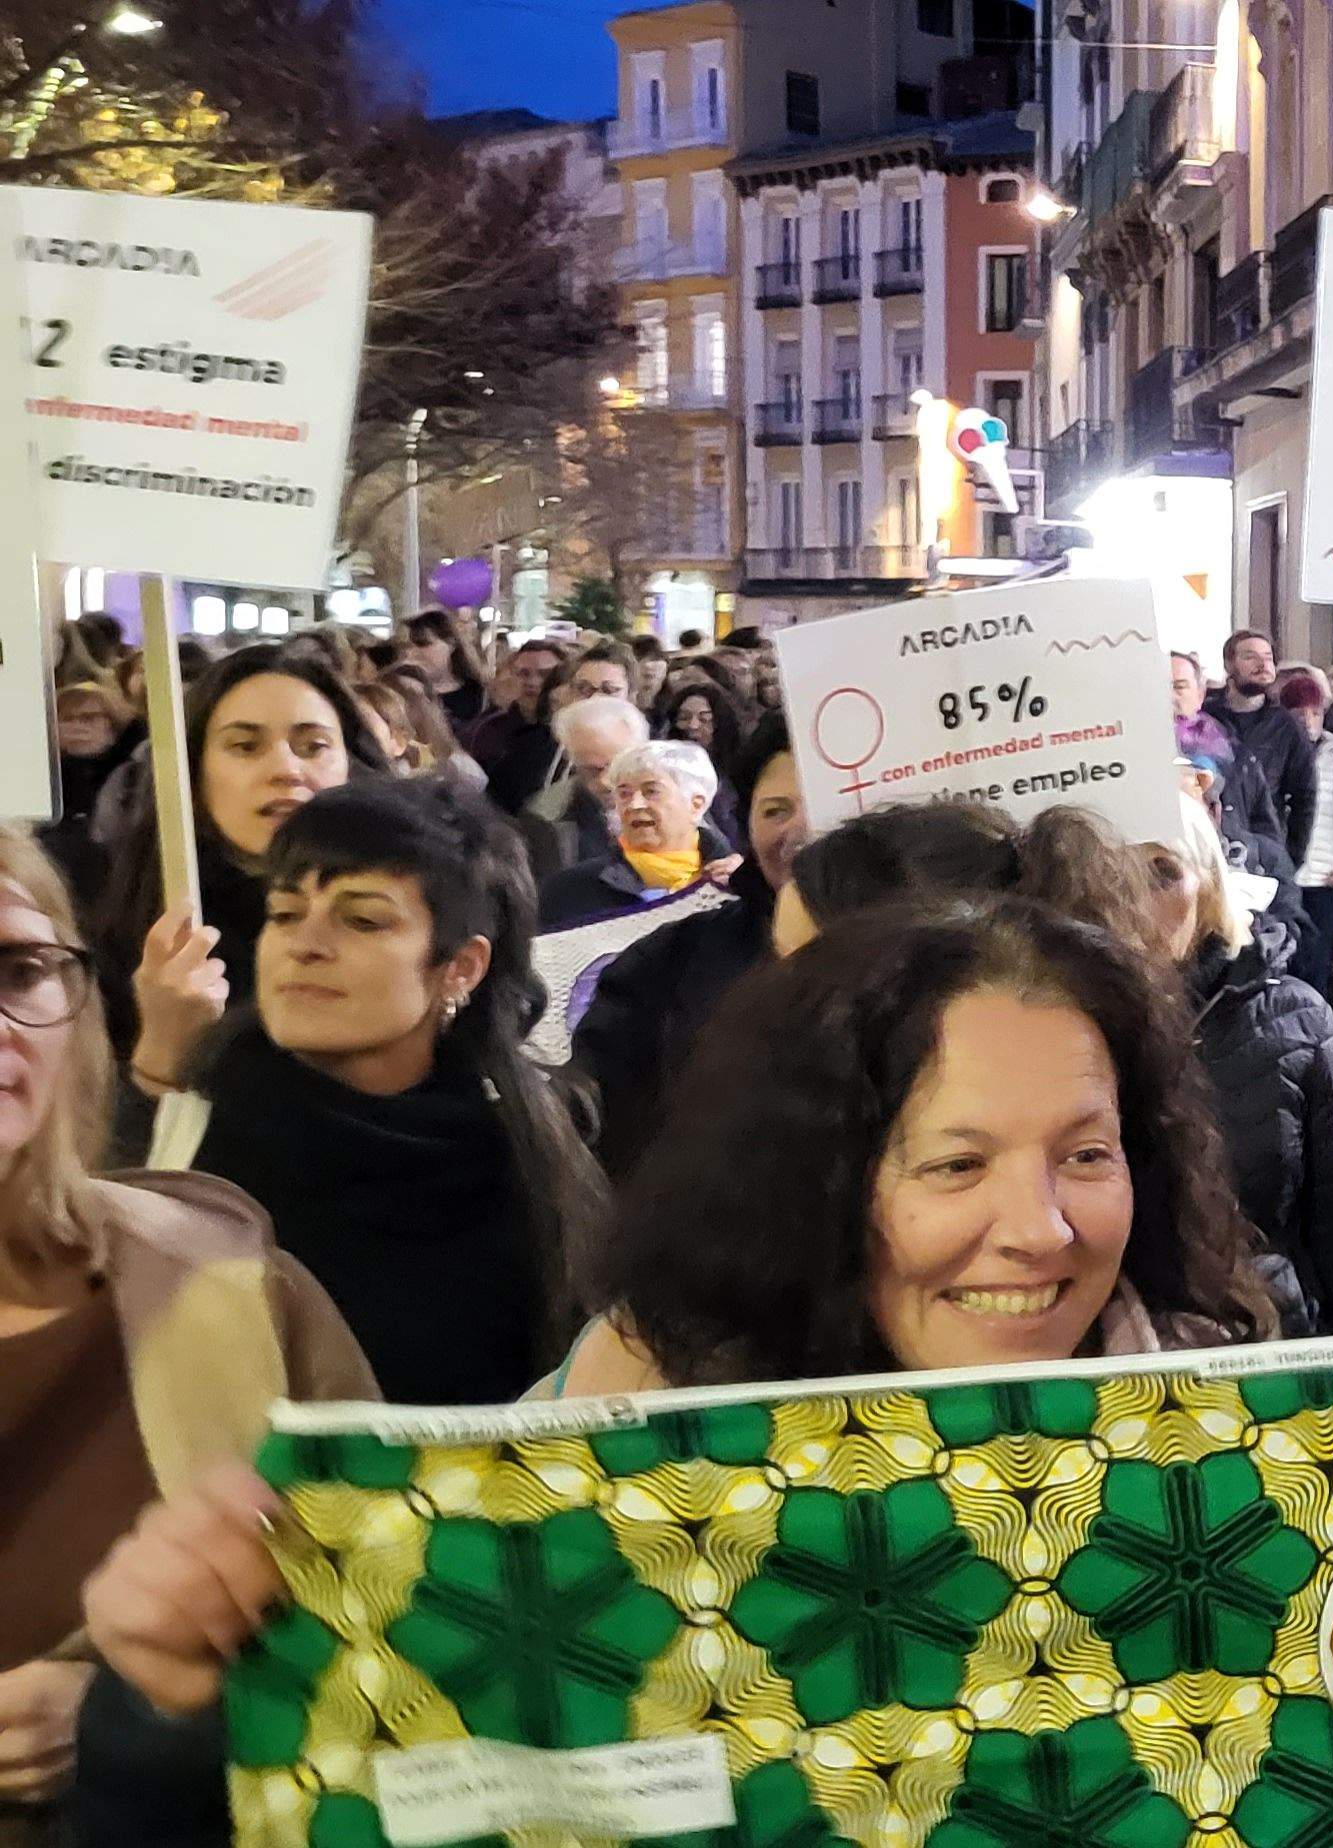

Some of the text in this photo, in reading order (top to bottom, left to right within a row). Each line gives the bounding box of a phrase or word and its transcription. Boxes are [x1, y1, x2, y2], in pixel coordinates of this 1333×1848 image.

[105, 341, 287, 386] estigma
[938, 675, 1049, 731] 85%
[880, 719, 1125, 784] con enfermedad mental
[1011, 760, 1127, 796] empleo
